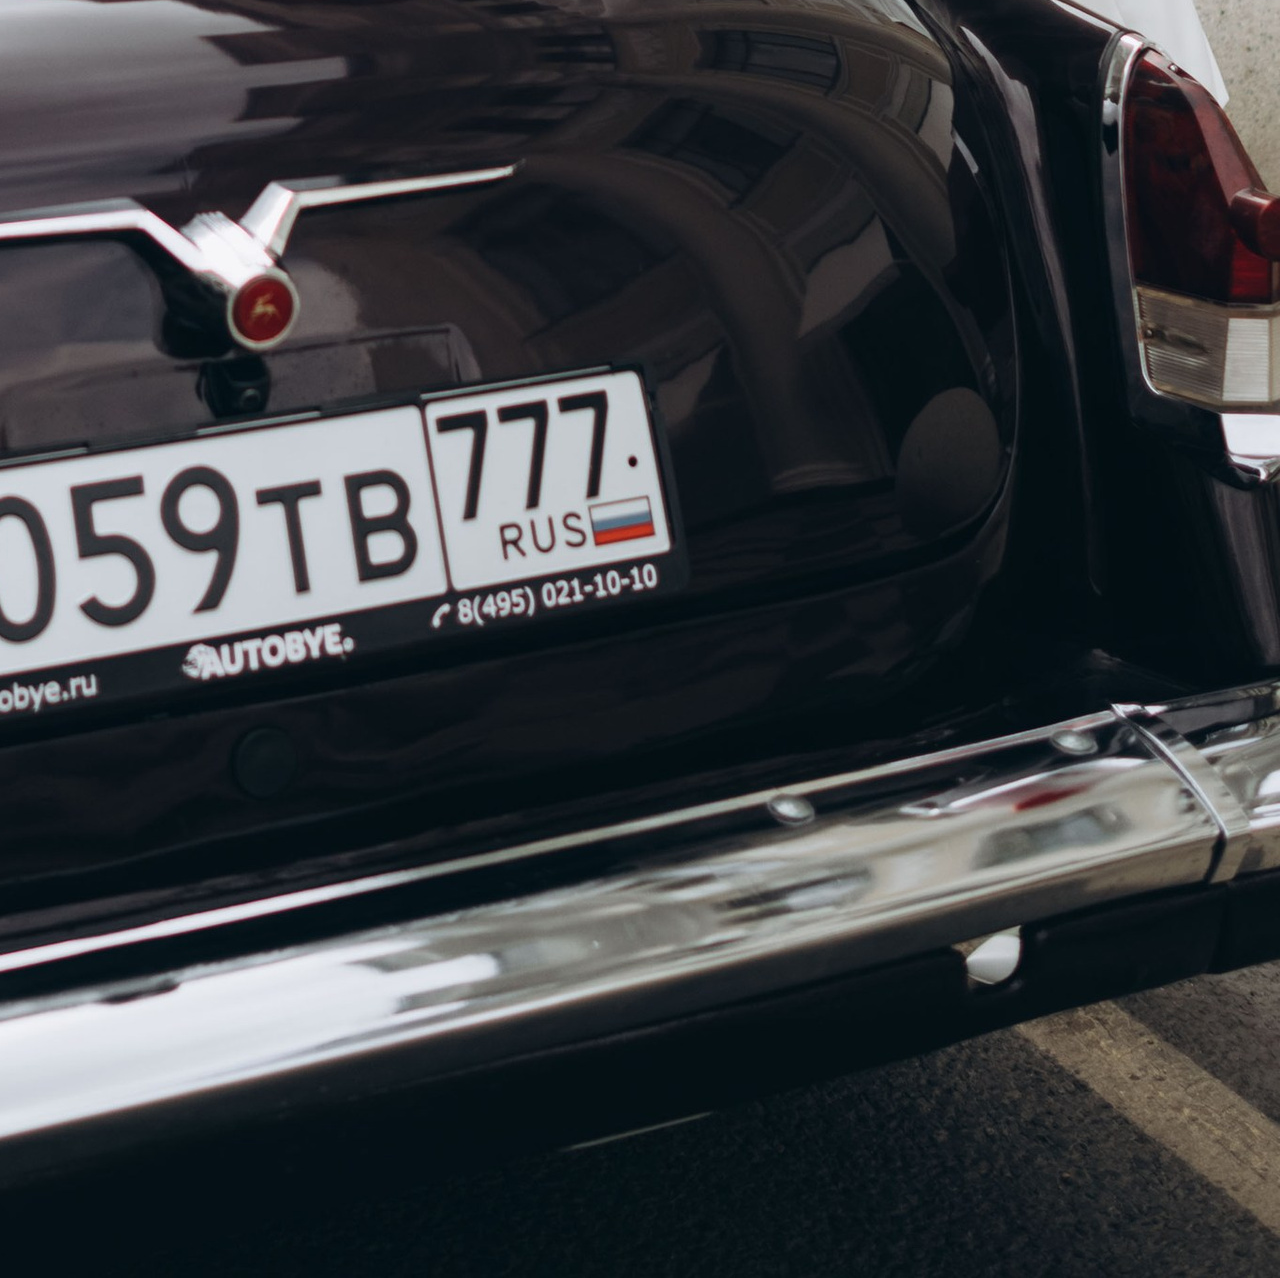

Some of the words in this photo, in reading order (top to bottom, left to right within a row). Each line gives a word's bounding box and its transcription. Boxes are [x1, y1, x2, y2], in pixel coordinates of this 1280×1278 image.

[435, 389, 608, 521] 777
[498, 512, 587, 561] RUS
[457, 585, 535, 626] 8(495)
[541, 563, 658, 608] 021-10-10
